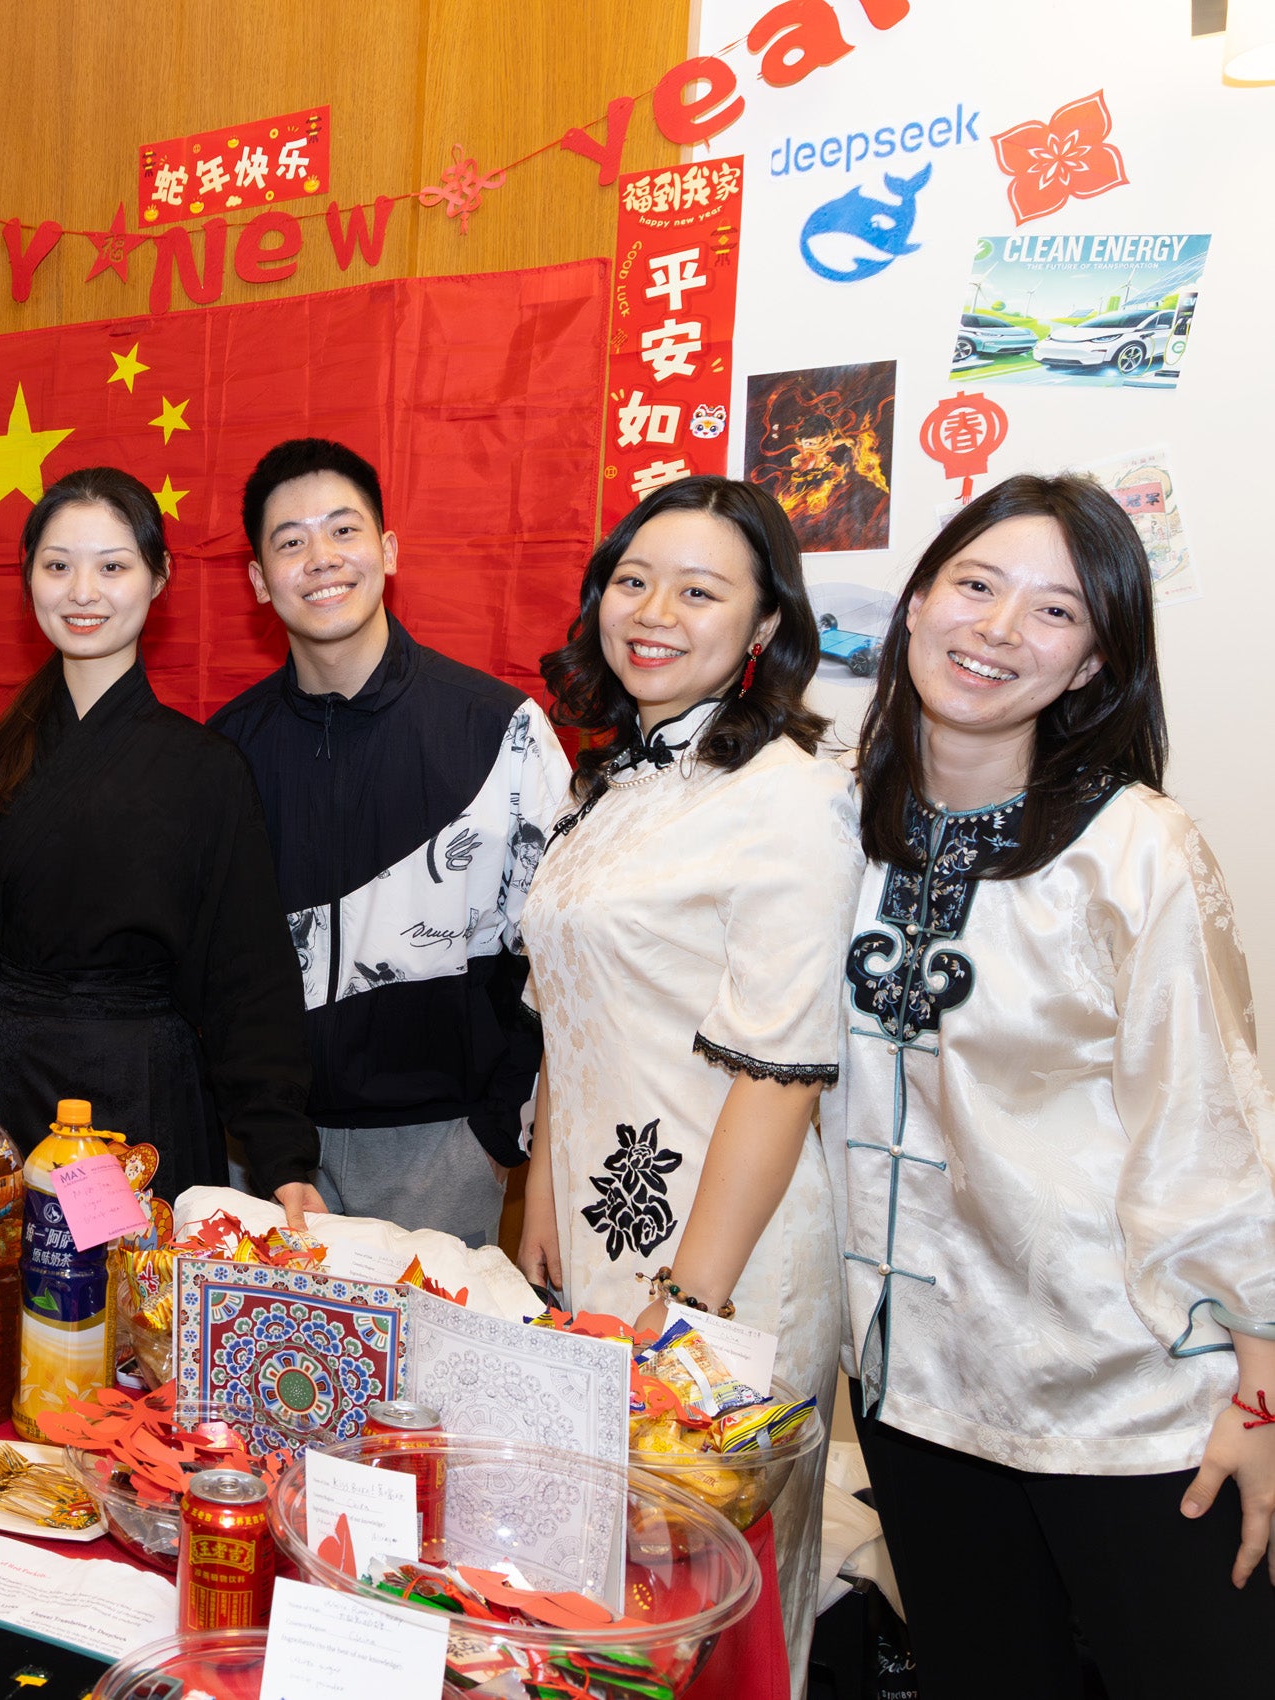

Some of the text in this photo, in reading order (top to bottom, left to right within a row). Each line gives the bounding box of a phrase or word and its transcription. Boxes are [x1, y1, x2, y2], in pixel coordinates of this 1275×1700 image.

[771, 103, 981, 178] deepseek
[151, 137, 310, 206] 蛇年快乐
[622, 162, 742, 214] 福到我家
[639, 205, 724, 228] happy new year
[149, 195, 395, 315] New
[1003, 234, 1190, 263] CLEAN ENERGY
[1045, 262, 1078, 271] FUTURE
[1080, 262, 1092, 270] OF
[616, 240, 643, 318] GOOD LUCK
[943, 412, 985, 453] 春
[31, 1247, 73, 1268] 原味奶茶
[198, 1541, 244, 1564] 王老吉
